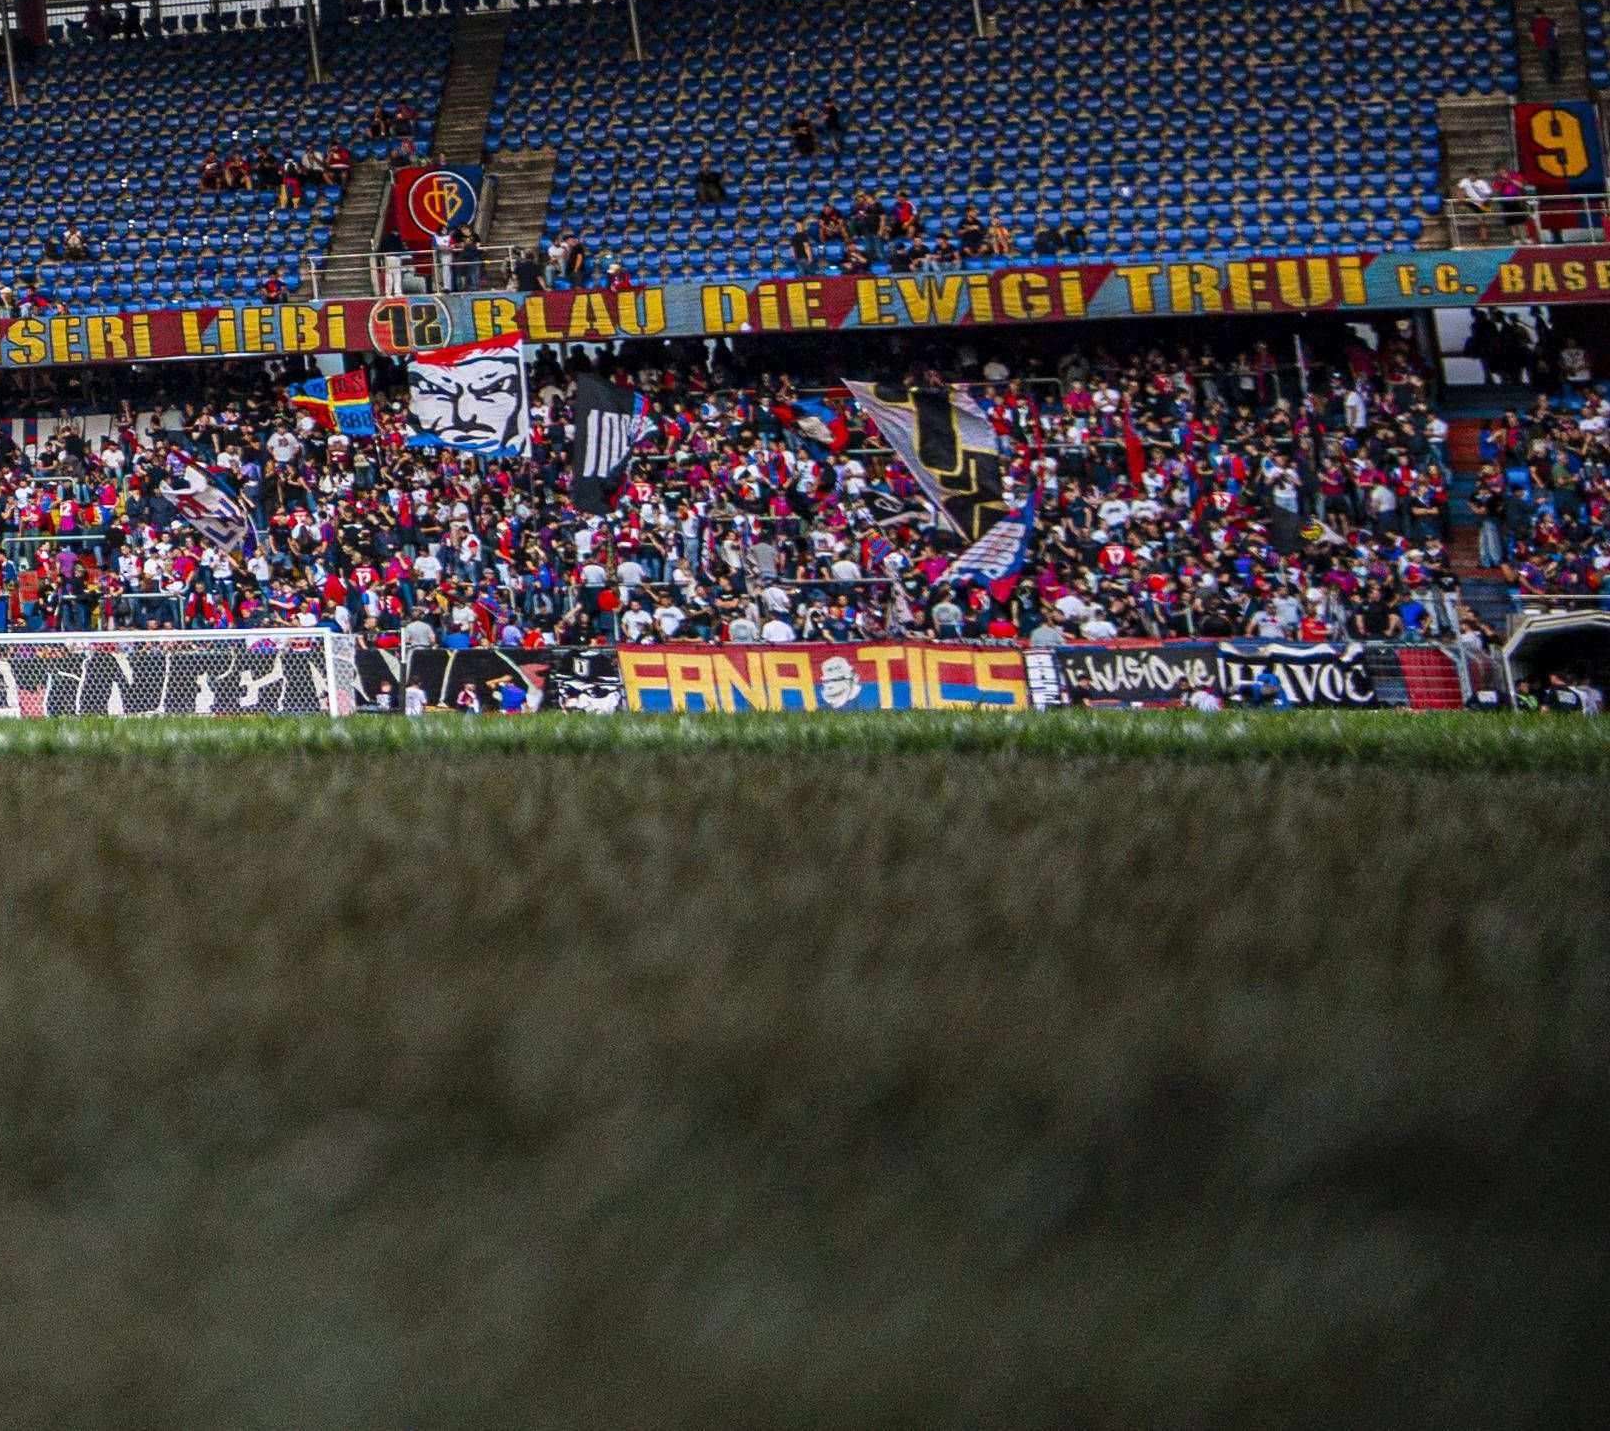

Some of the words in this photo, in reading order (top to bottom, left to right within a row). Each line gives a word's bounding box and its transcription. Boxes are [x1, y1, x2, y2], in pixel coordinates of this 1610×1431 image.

[1529, 108, 1591, 179] 9
[374, 303, 443, 352] 12
[471, 286, 669, 341] BLAU
[1397, 264, 1478, 296] F.C.
